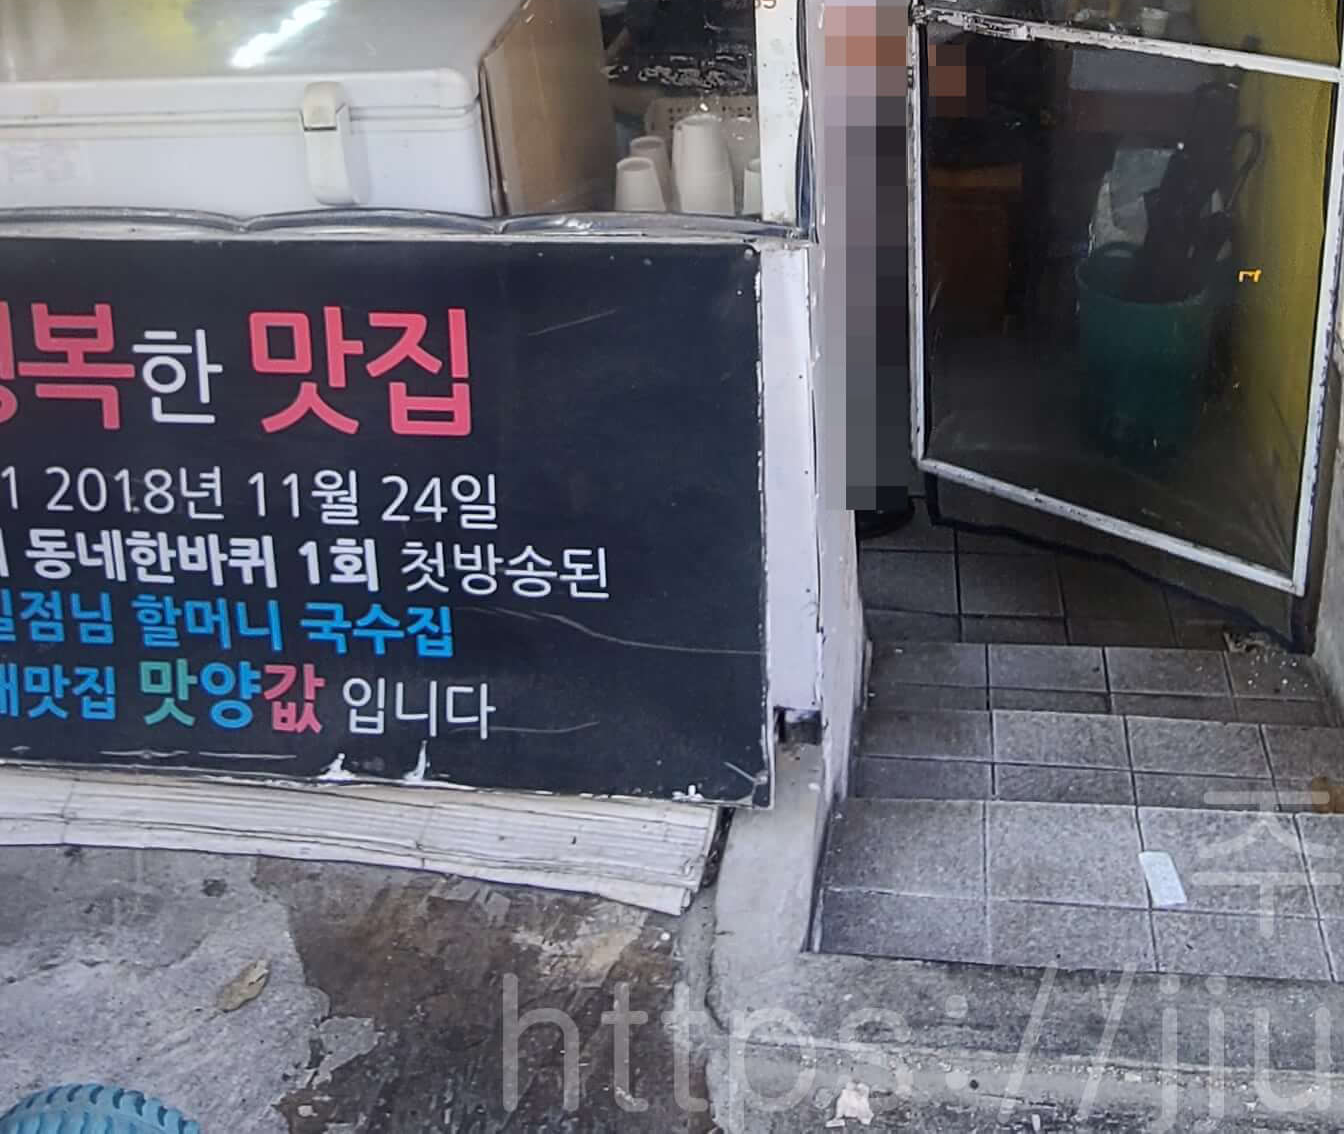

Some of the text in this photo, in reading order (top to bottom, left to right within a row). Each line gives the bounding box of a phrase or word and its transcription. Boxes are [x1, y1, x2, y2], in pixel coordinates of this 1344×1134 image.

[249, 305, 472, 437] 맛집
[45, 465, 226, 522] 2018년
[248, 468, 361, 526] 11월
[381, 471, 499, 532] 24일
[25, 527, 278, 590] 동네한바퀴
[298, 537, 380, 593] 1회
[401, 540, 612, 600] 첫방송된
[131, 592, 283, 652] 할머니
[299, 601, 454, 659] 국수집
[138, 659, 325, 734] 맛양값
[341, 677, 498, 741] 입니다
